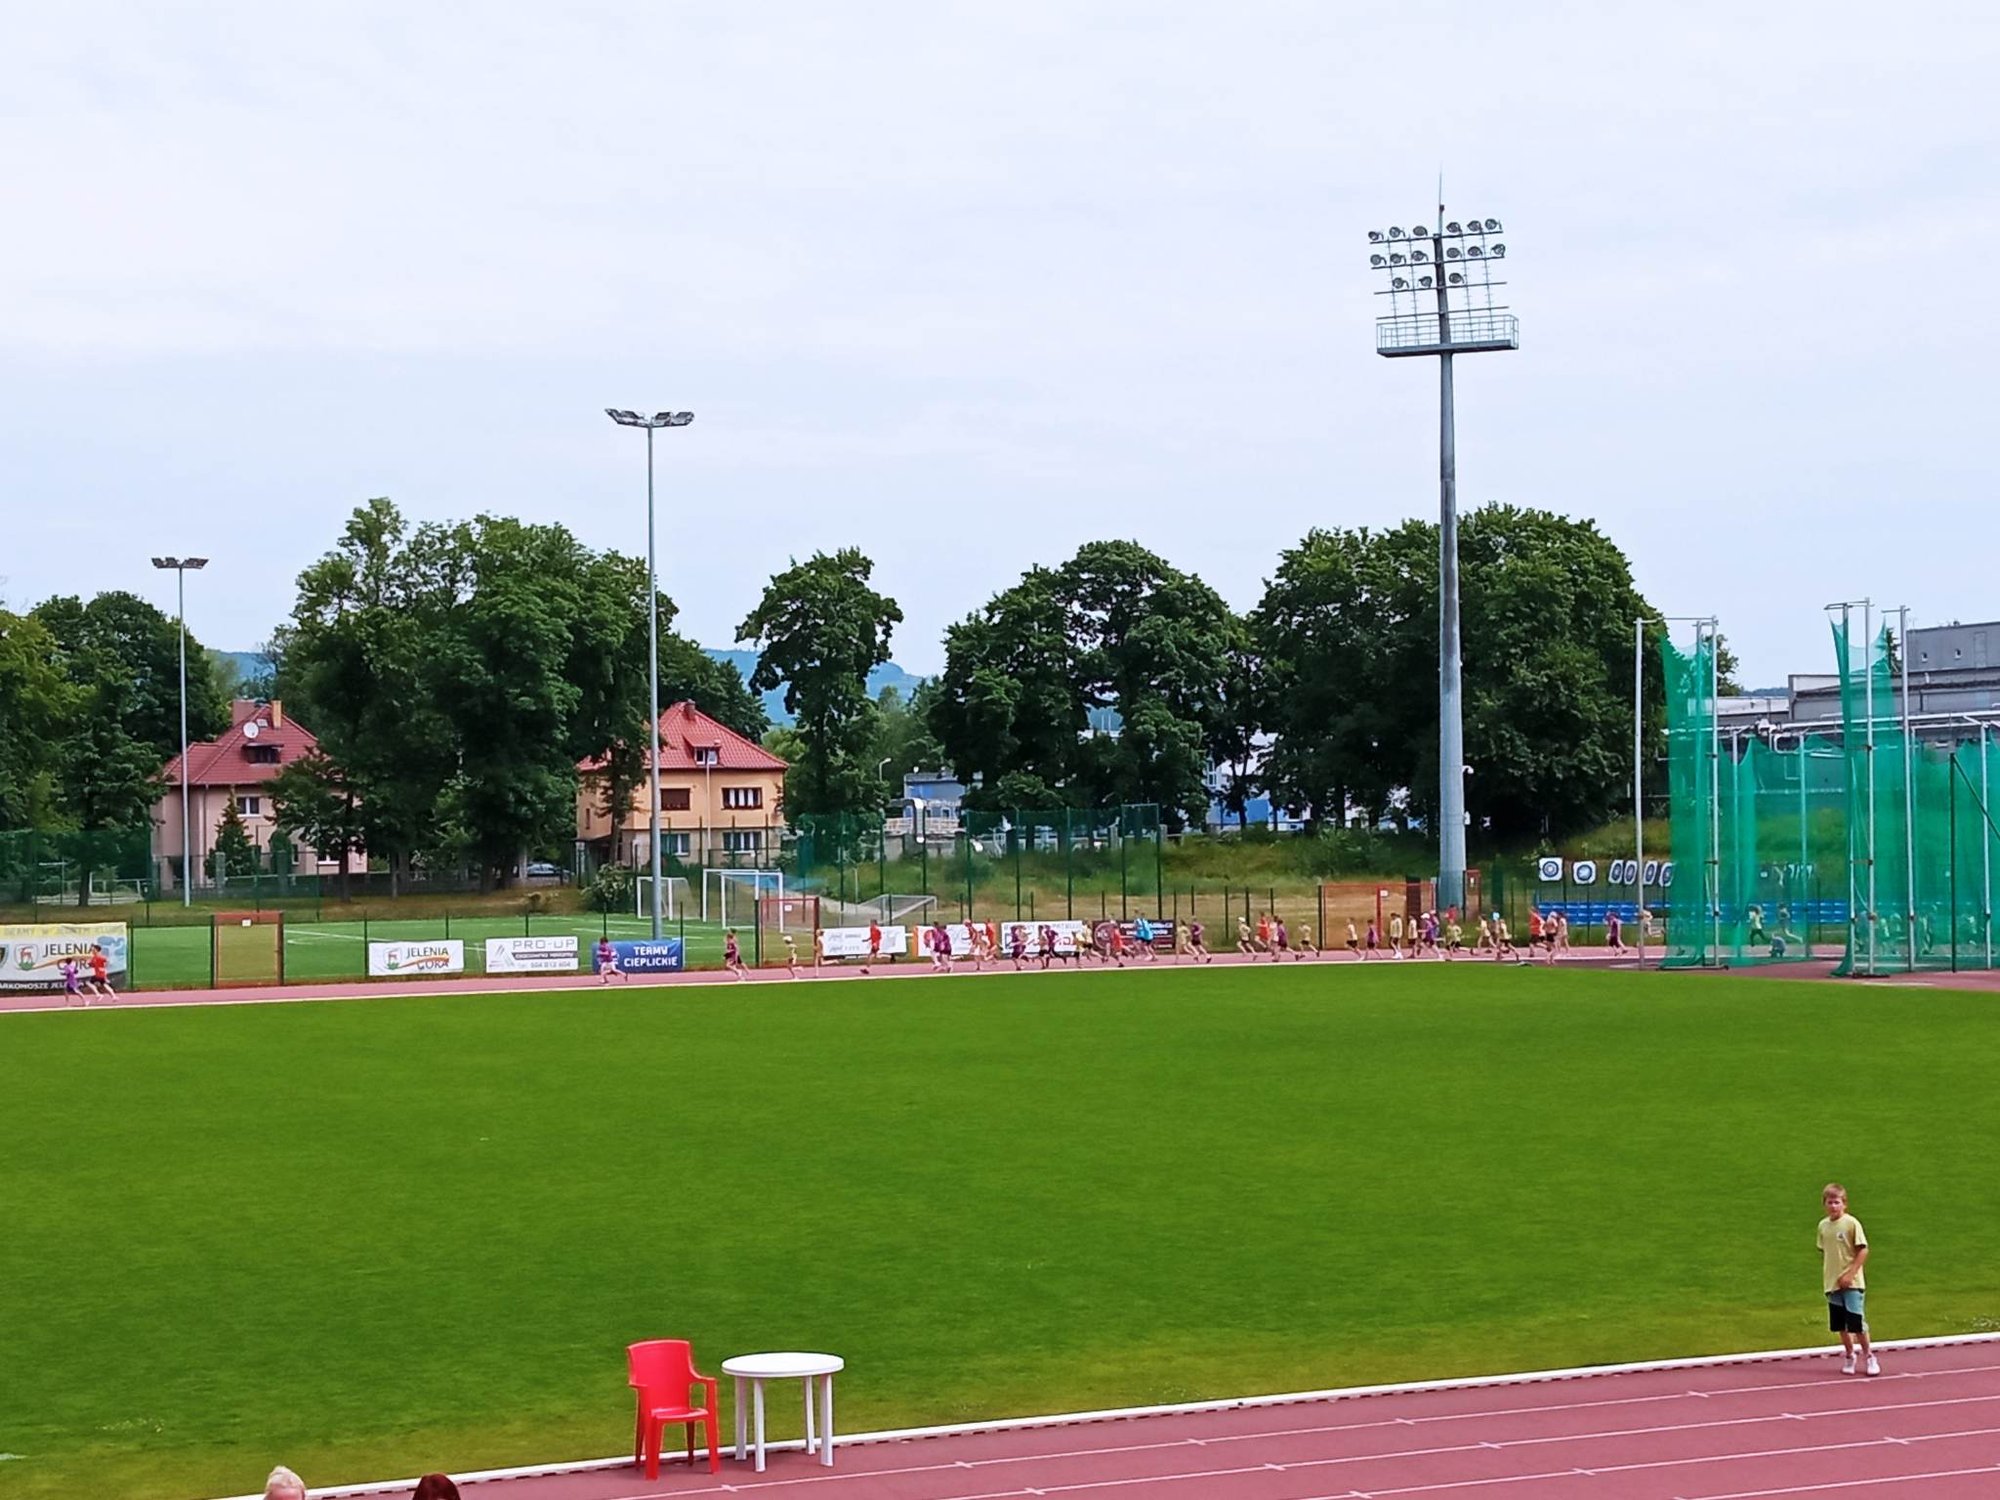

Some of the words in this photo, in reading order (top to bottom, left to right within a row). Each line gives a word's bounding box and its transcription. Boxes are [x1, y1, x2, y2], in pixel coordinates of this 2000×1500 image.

[513, 939, 575, 950] PRO-UP
[406, 947, 449, 959] JELENIA
[624, 957, 678, 967] CIEPLICKIE
[0, 981, 49, 990] ARKONOSZE
